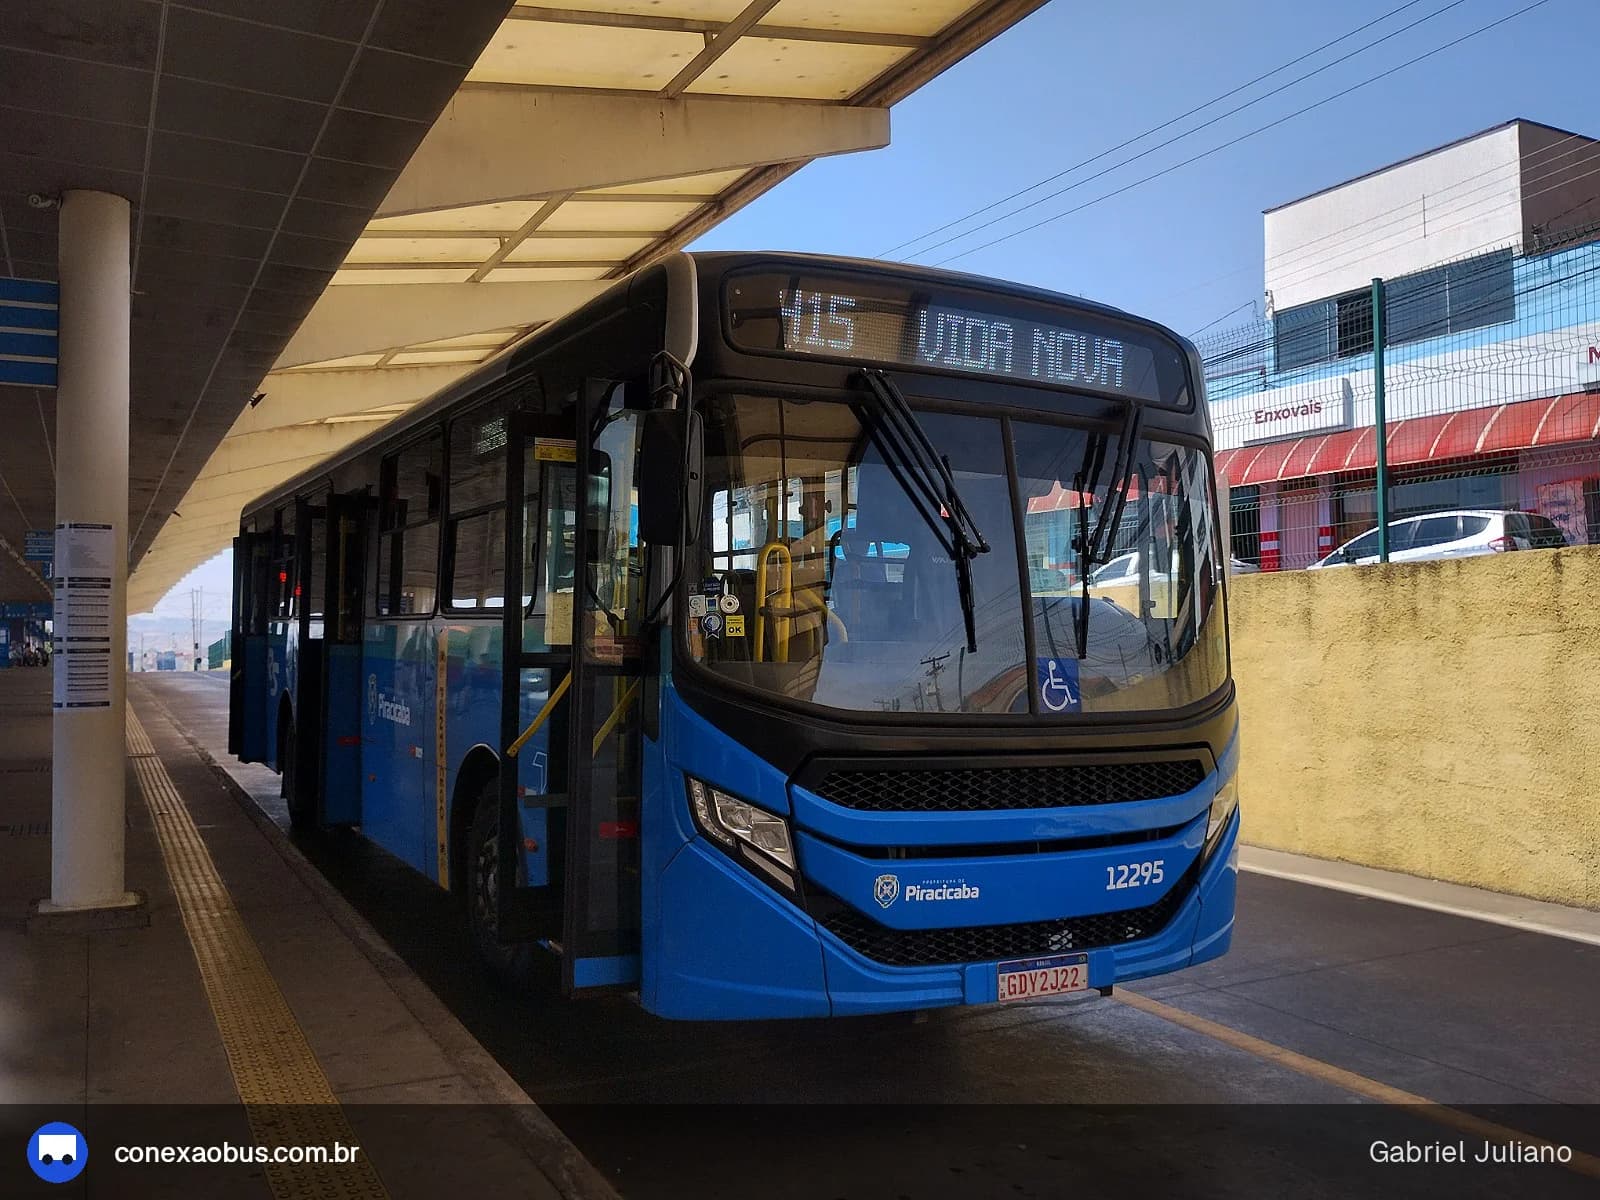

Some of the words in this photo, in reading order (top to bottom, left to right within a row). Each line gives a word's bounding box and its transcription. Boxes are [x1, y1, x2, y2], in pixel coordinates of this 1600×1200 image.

[778, 288, 857, 351] 415
[918, 308, 1013, 373] VIDA
[1031, 326, 1124, 388] NOVA
[1254, 400, 1322, 424] Enxovais
[728, 626, 742, 634] OK
[1106, 860, 1165, 891] 12295
[905, 883, 979, 902] Piracicaba
[1007, 967, 1079, 996] GDY2J22
